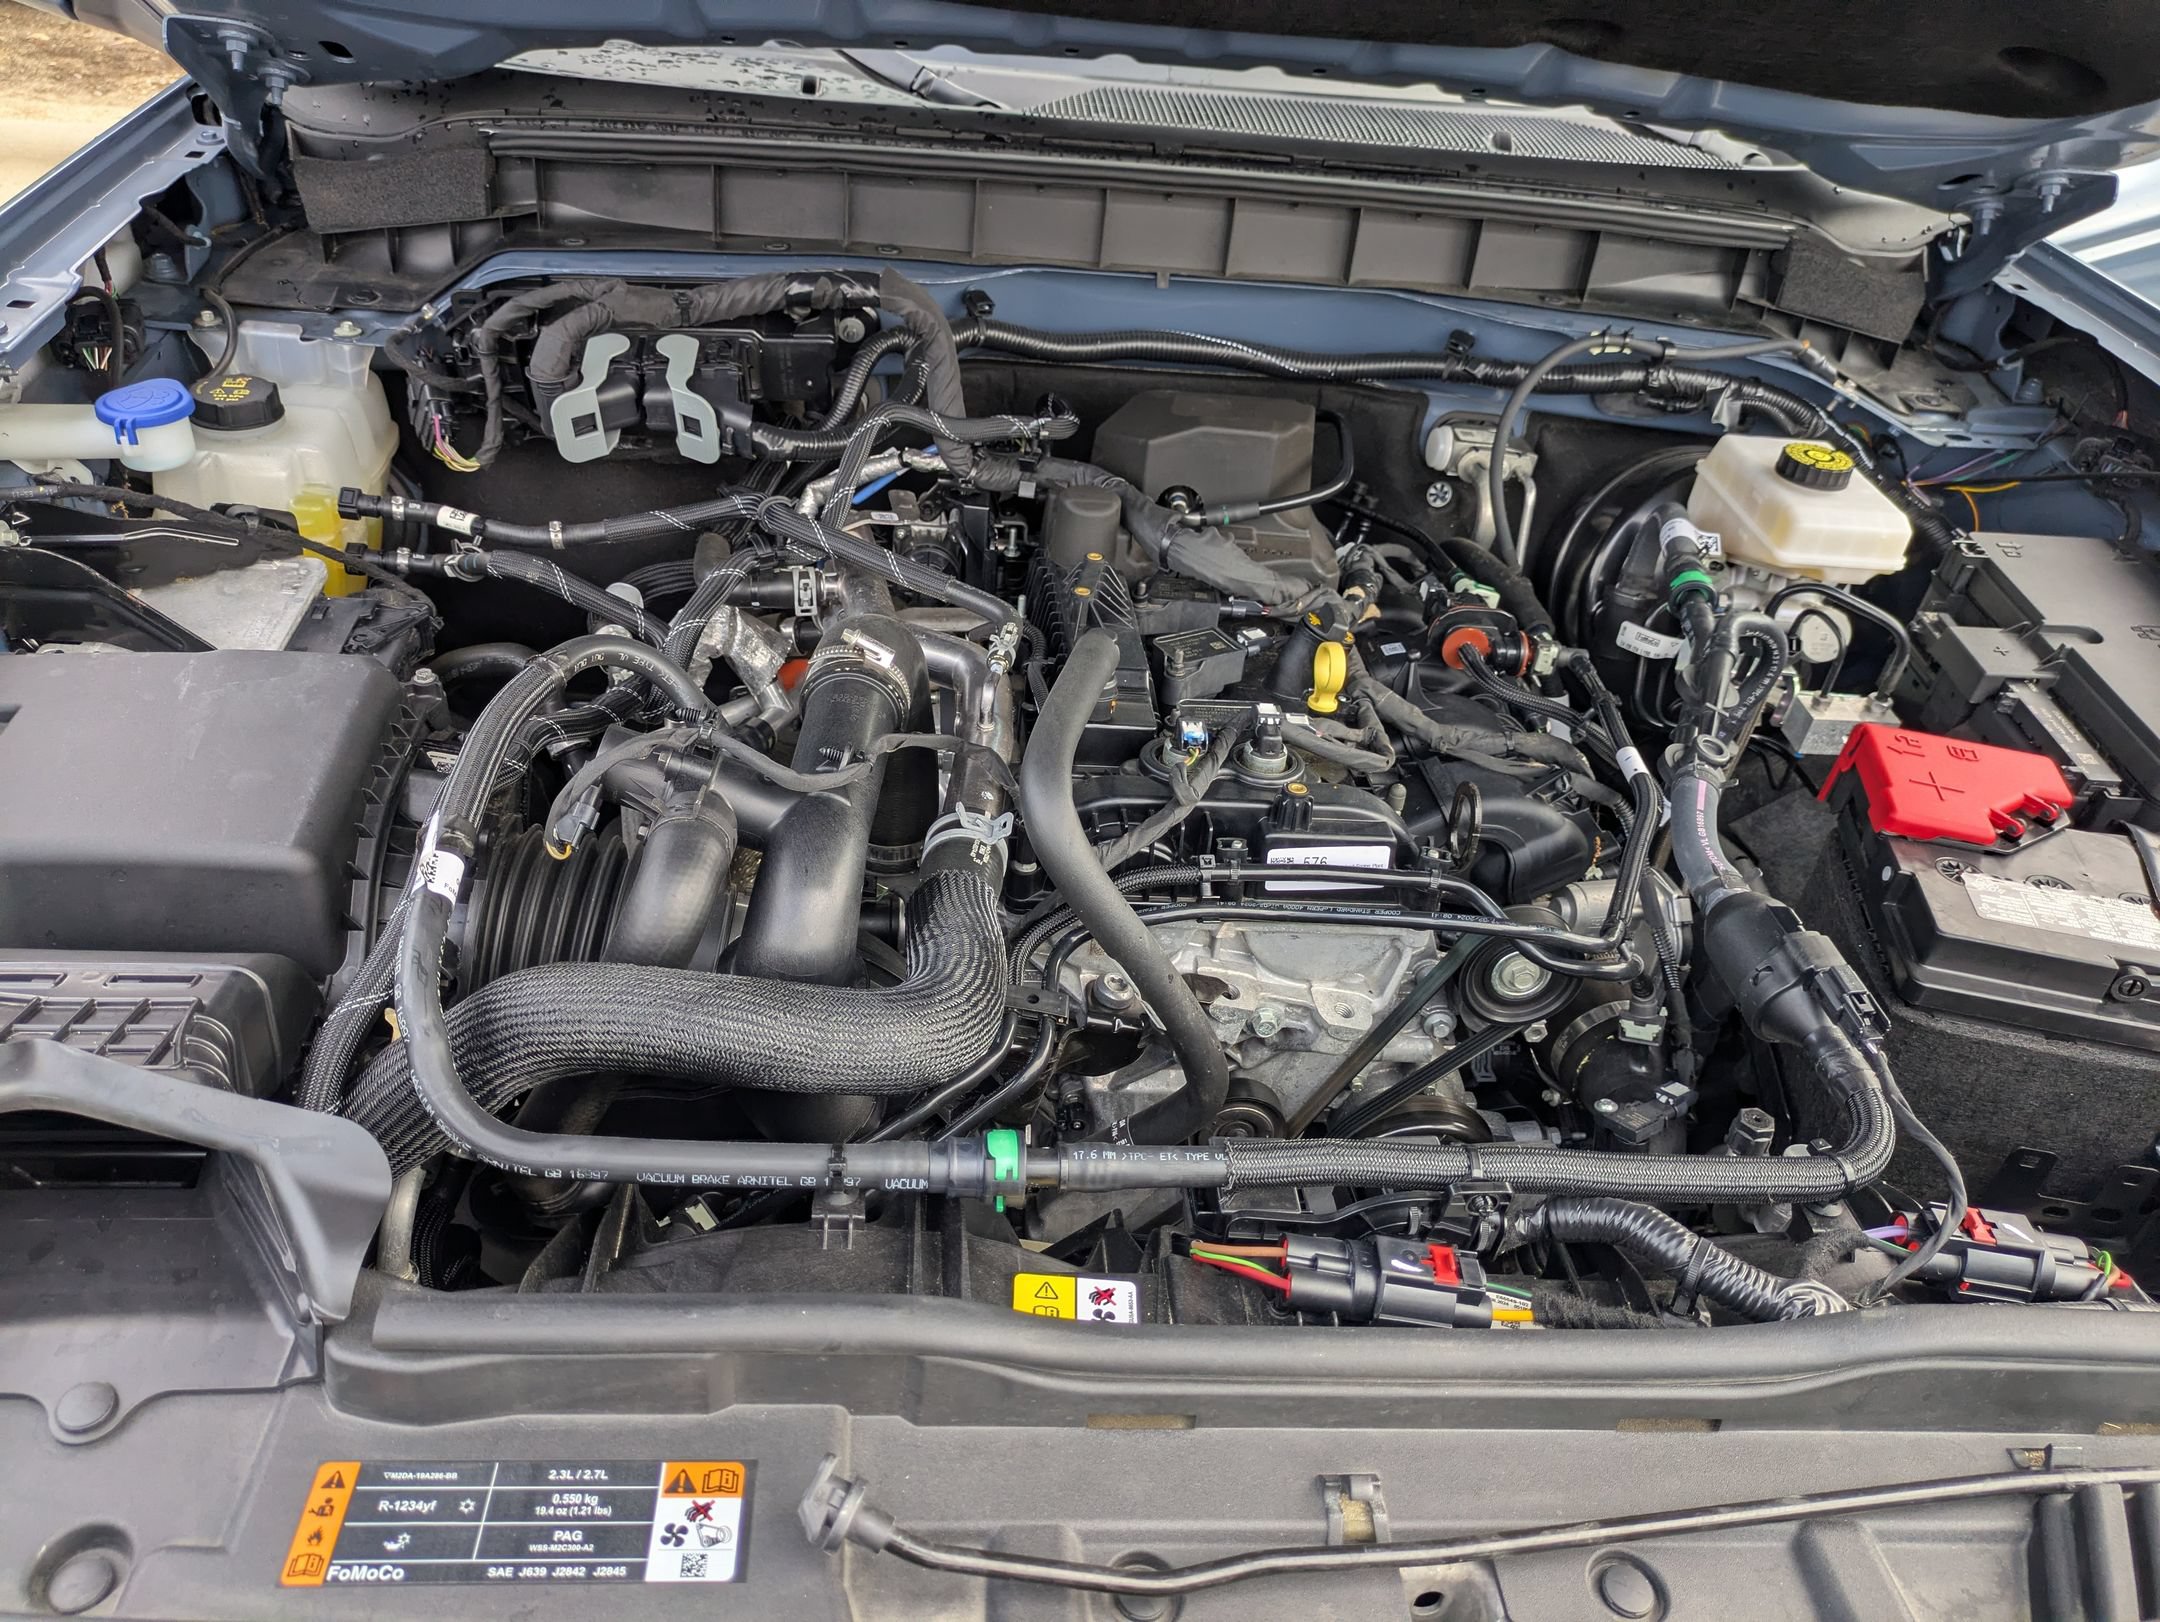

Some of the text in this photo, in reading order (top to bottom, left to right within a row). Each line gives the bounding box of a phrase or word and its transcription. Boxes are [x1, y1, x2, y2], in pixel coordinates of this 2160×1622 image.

[1072, 1149, 1098, 1160] 17.6
[1186, 1151, 1210, 1161] TYPE
[692, 1173, 730, 1185] BRAKE
[737, 1174, 792, 1186] ARNITEL
[800, 1175, 816, 1187] GB
[823, 1176, 862, 1188] 197
[548, 1469, 575, 1481] 2.3L
[584, 1469, 608, 1481] 2.7L
[552, 1493, 599, 1506] 0.550 kg
[378, 1500, 437, 1513] R-1234yf
[534, 1506, 612, 1517] 19.4 oz (1.21 lbs)
[553, 1530, 583, 1542] PAG
[326, 1565, 405, 1581] FoMoCo
[487, 1566, 627, 1578] SAE J639 J2842 J2845
